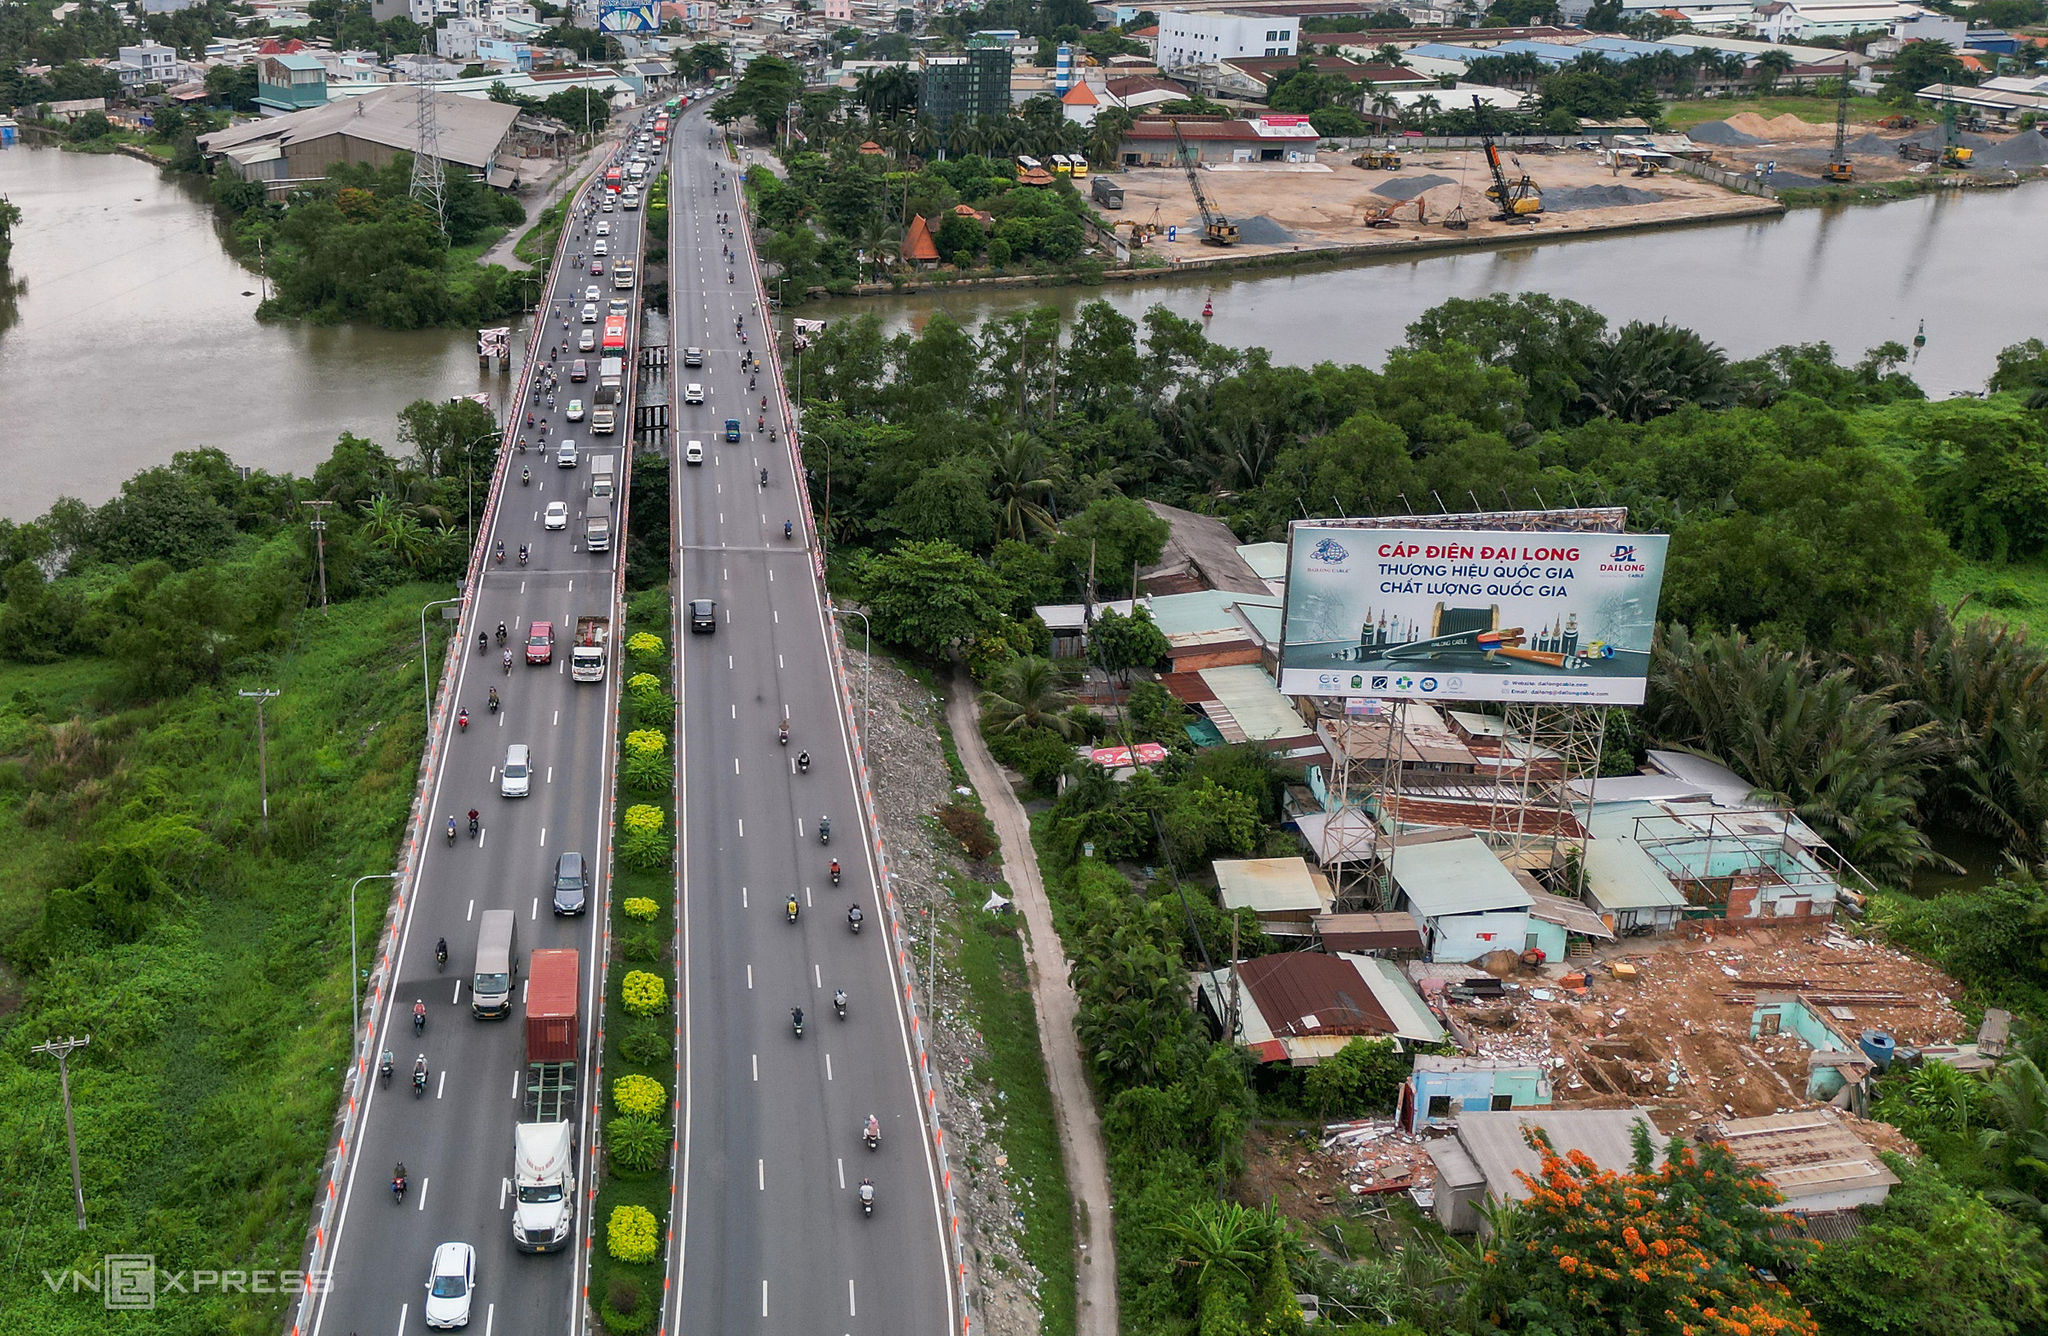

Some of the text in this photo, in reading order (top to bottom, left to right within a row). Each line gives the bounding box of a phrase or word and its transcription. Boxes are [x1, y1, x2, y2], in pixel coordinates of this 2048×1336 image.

[1377, 541, 1580, 563] CÁP ĐIỆN ĐẠI LONG
[1378, 562, 1575, 580] THƯƠNG HIỆU QUỐC GIA
[1600, 564, 1645, 572] DAILONG
[1380, 578, 1567, 597] CHẤT LƯỢNG QUỐC GIA
